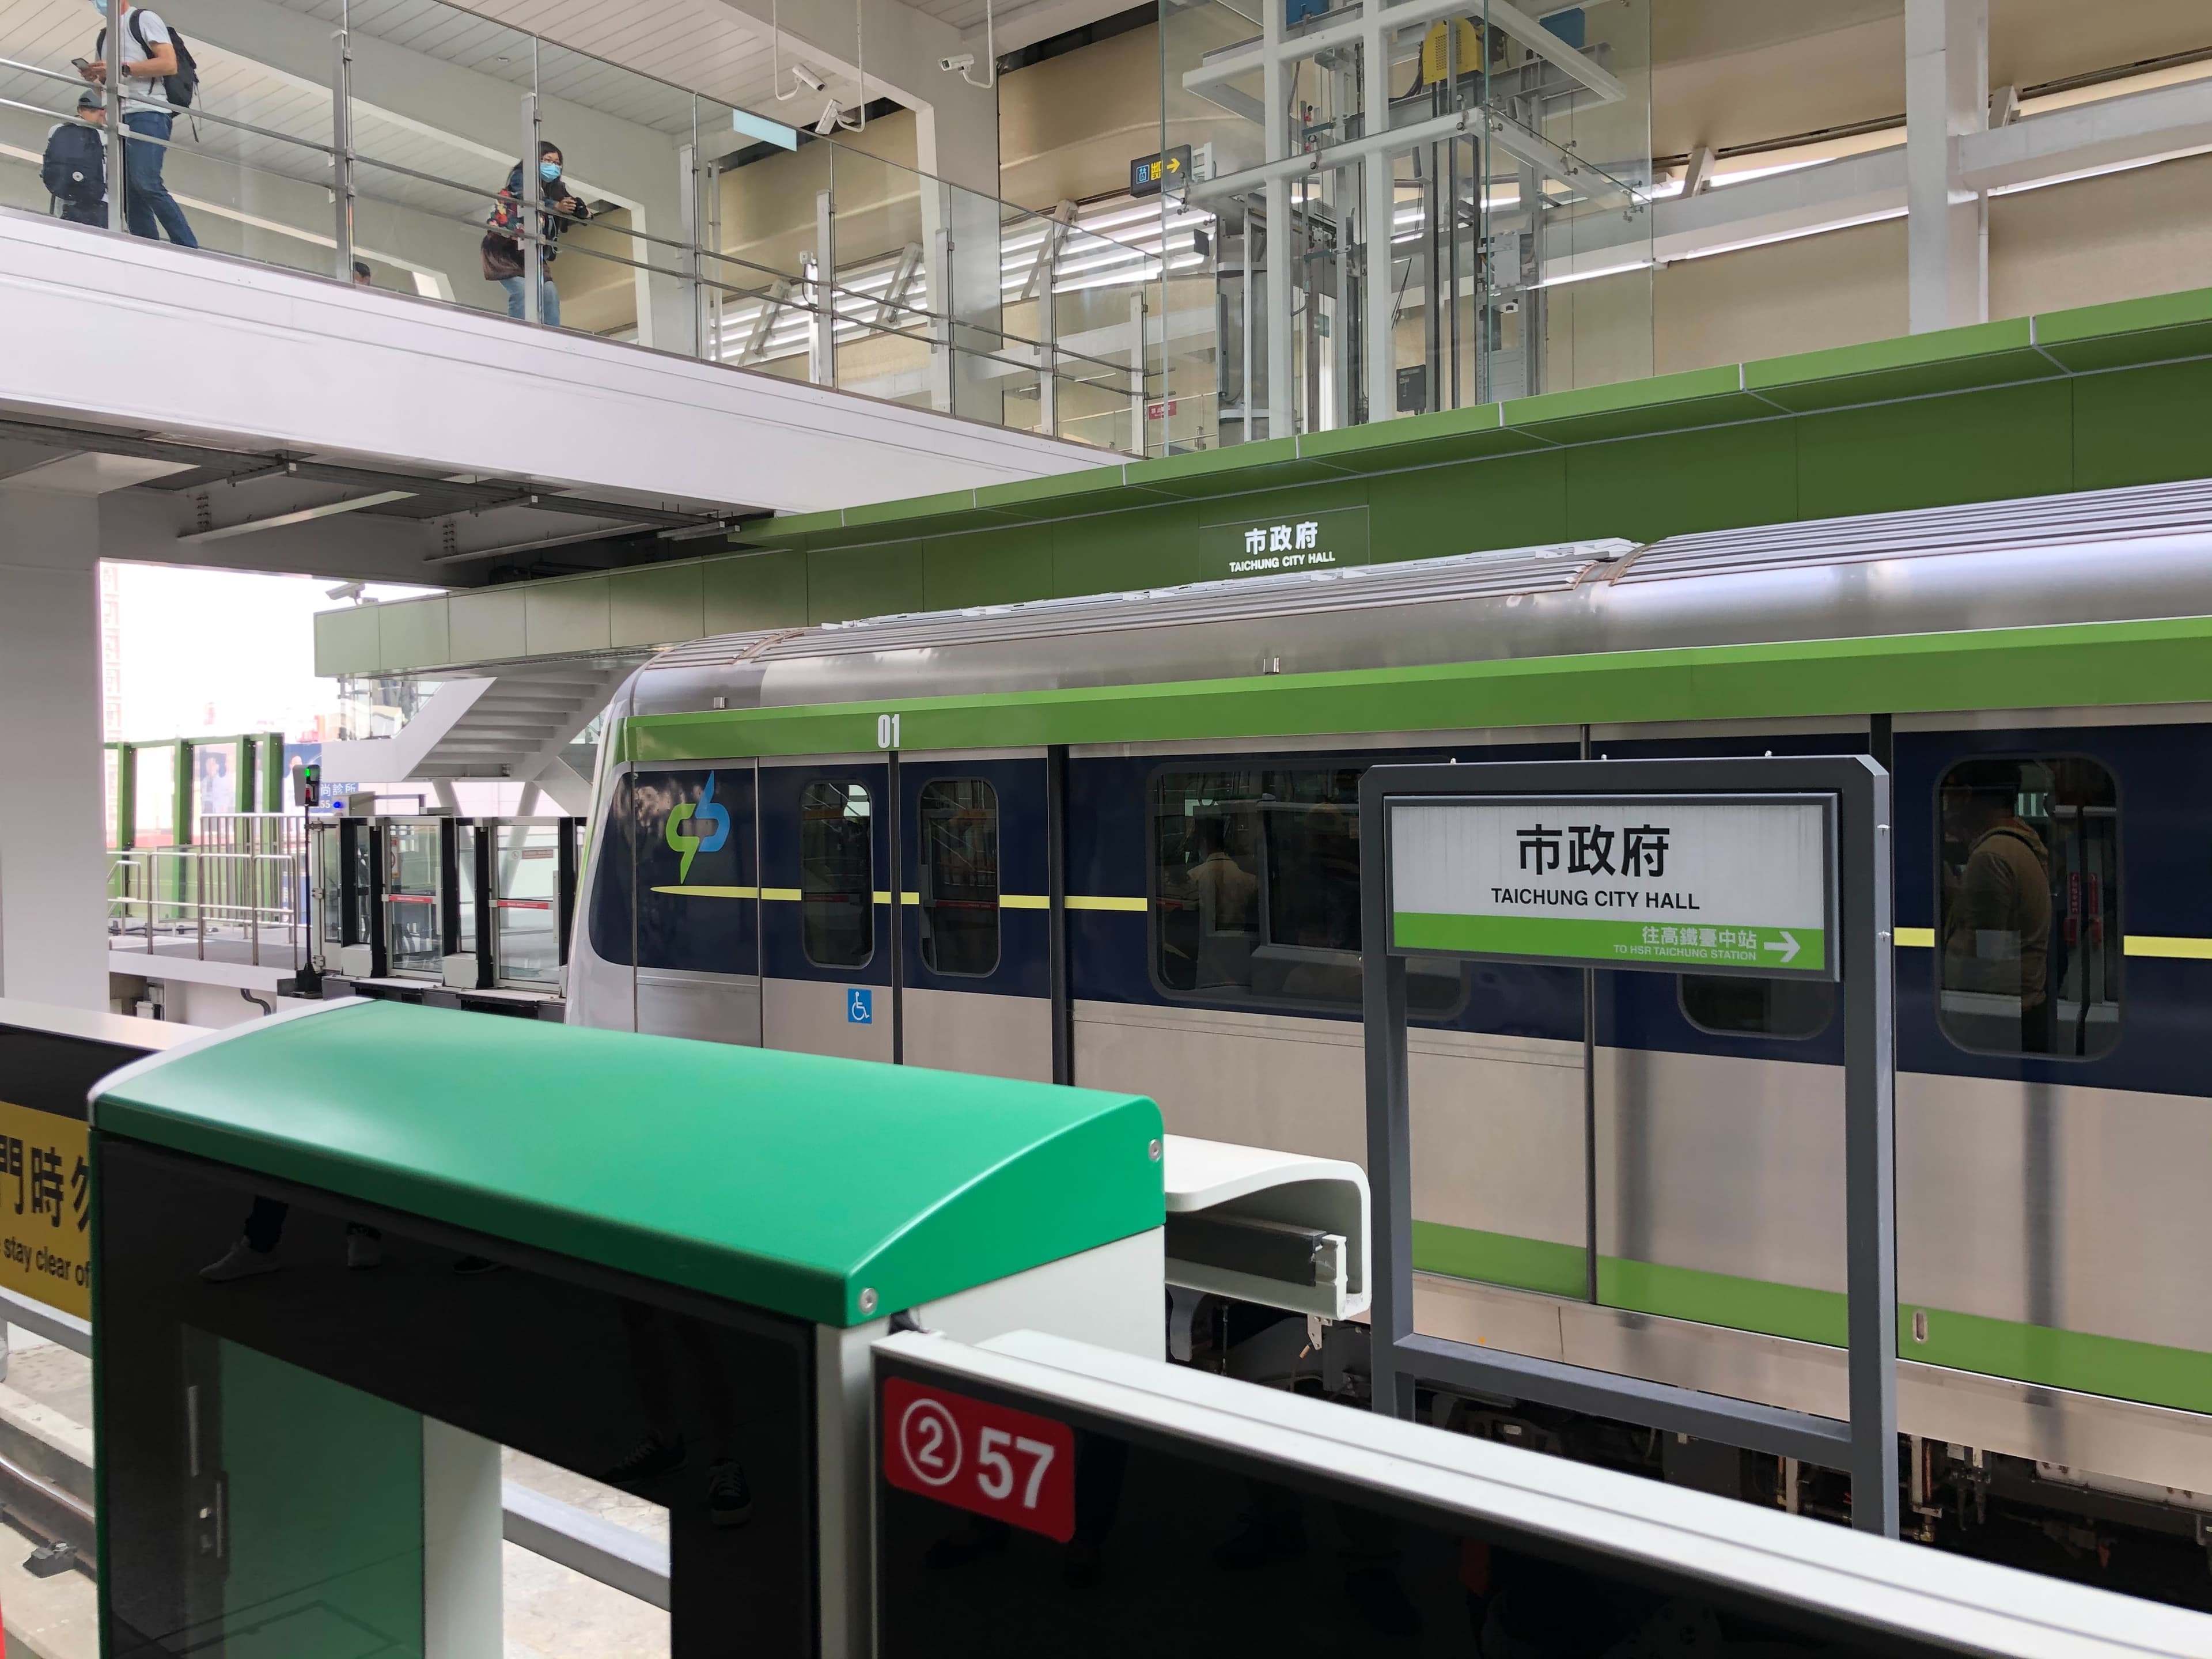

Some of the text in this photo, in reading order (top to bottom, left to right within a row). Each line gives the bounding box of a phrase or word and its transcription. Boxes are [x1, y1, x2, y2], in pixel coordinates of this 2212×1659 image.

[1244, 521, 1318, 555] 市政府
[1229, 551, 1335, 572] TAICHUNG CITY HALL
[878, 714, 899, 748] 01
[1516, 824, 1669, 877] 市政府
[1491, 888, 1700, 910] TAICHUNG CITY HALL
[1613, 945, 1756, 960] TO HSR TAICHUNG STATION
[1642, 926, 1756, 949] 往高鐵臺中站
[3, 1237, 32, 1272] stay
[36, 1246, 70, 1280] clear
[978, 1426, 1055, 1509] 57
